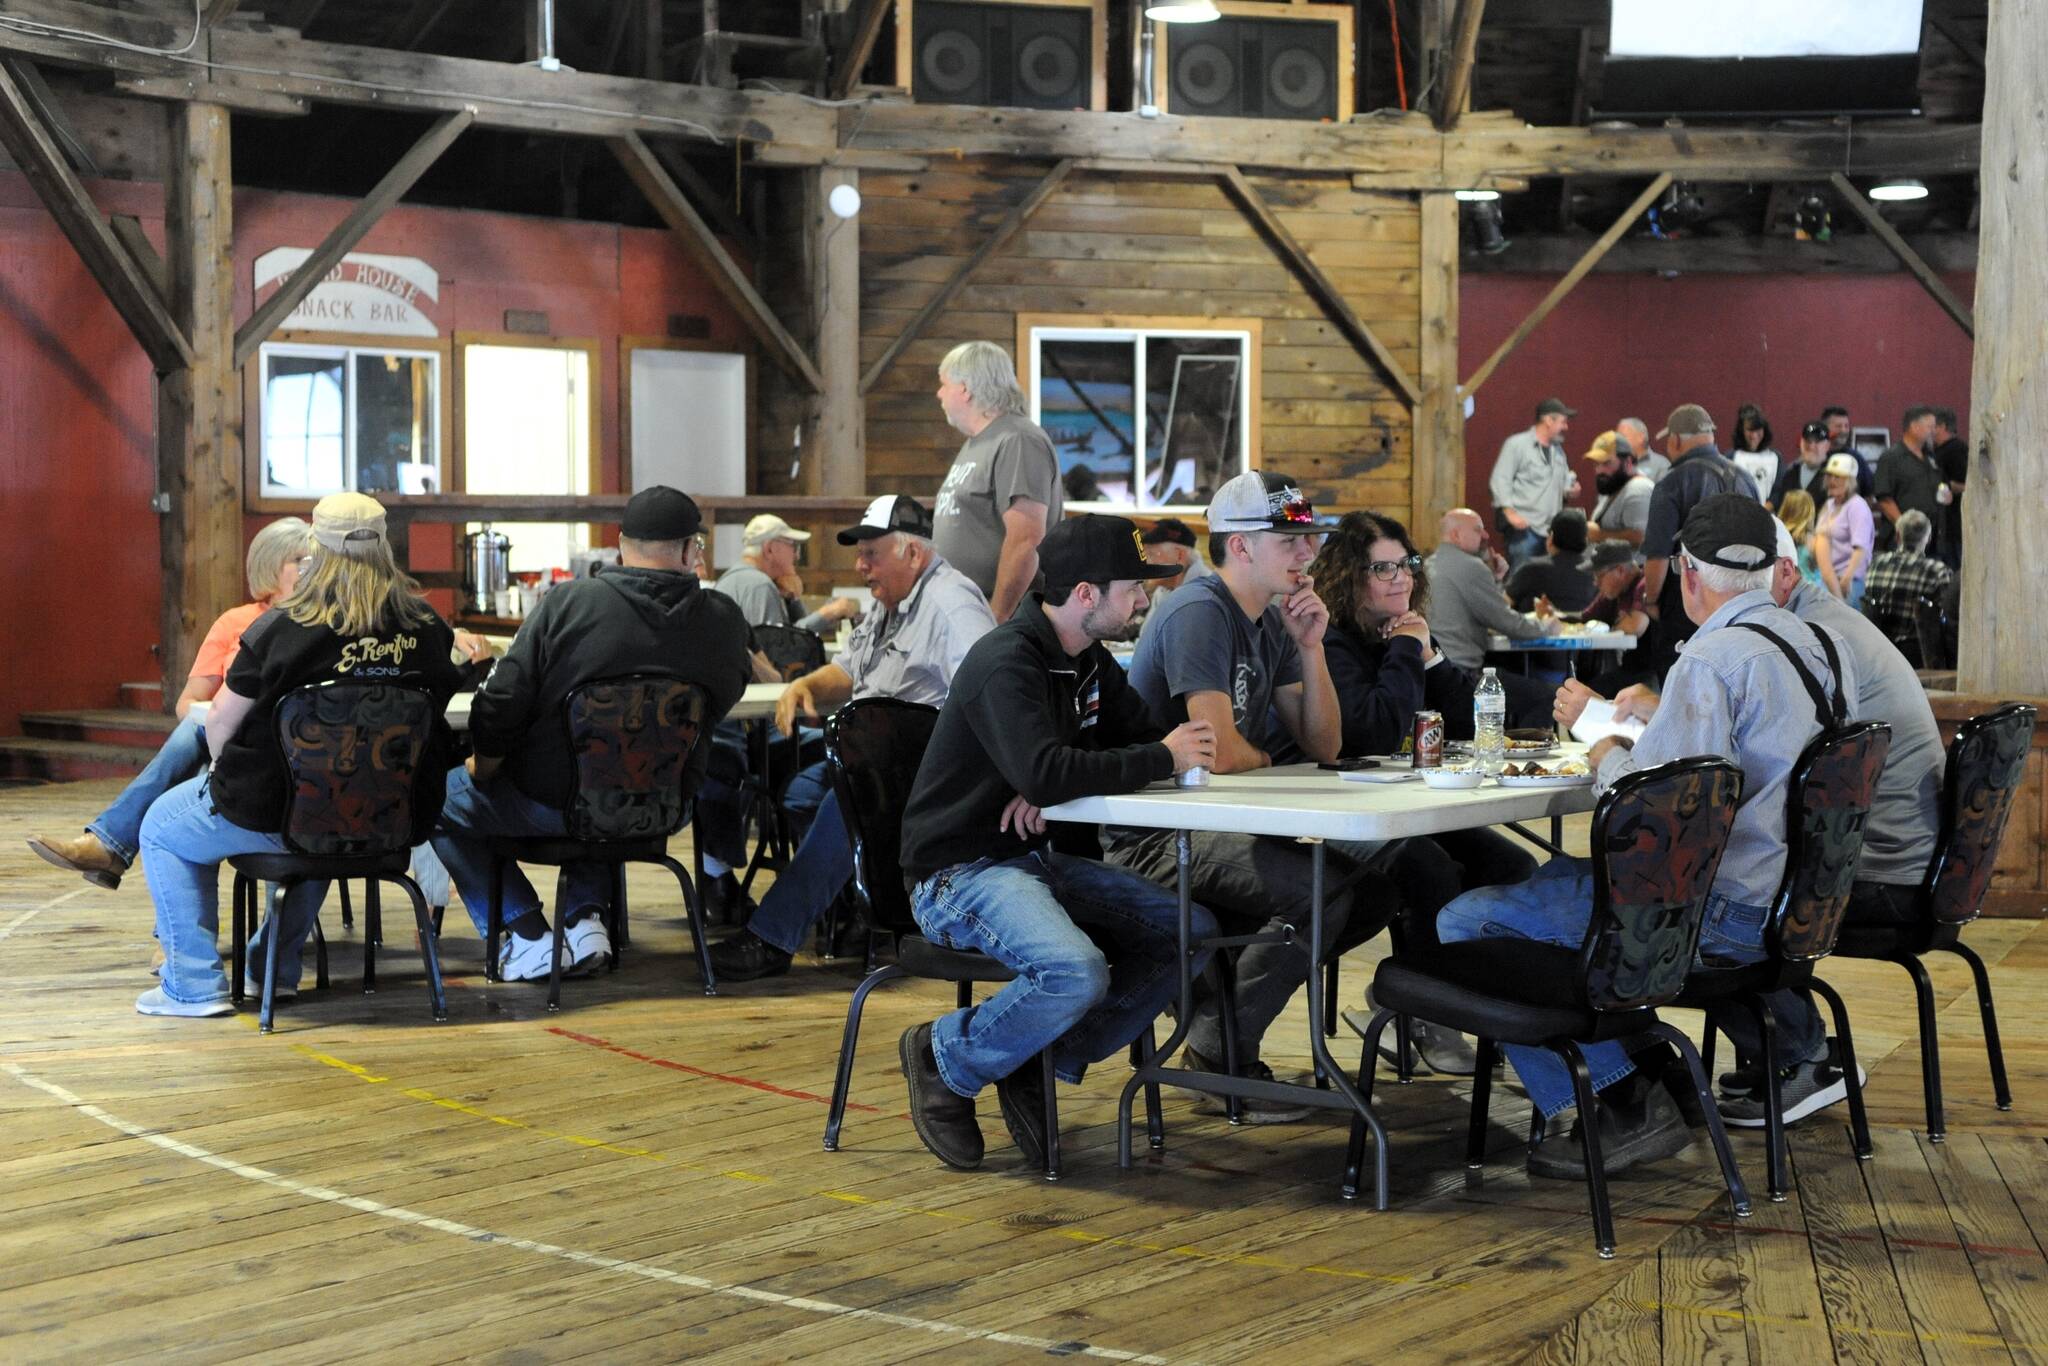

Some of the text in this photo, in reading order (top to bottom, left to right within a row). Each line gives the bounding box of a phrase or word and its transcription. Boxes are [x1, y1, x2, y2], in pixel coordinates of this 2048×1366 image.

[356, 264, 417, 304] HOUSE
[370, 303, 408, 322] BAR
[353, 667, 400, 676] & SONS
